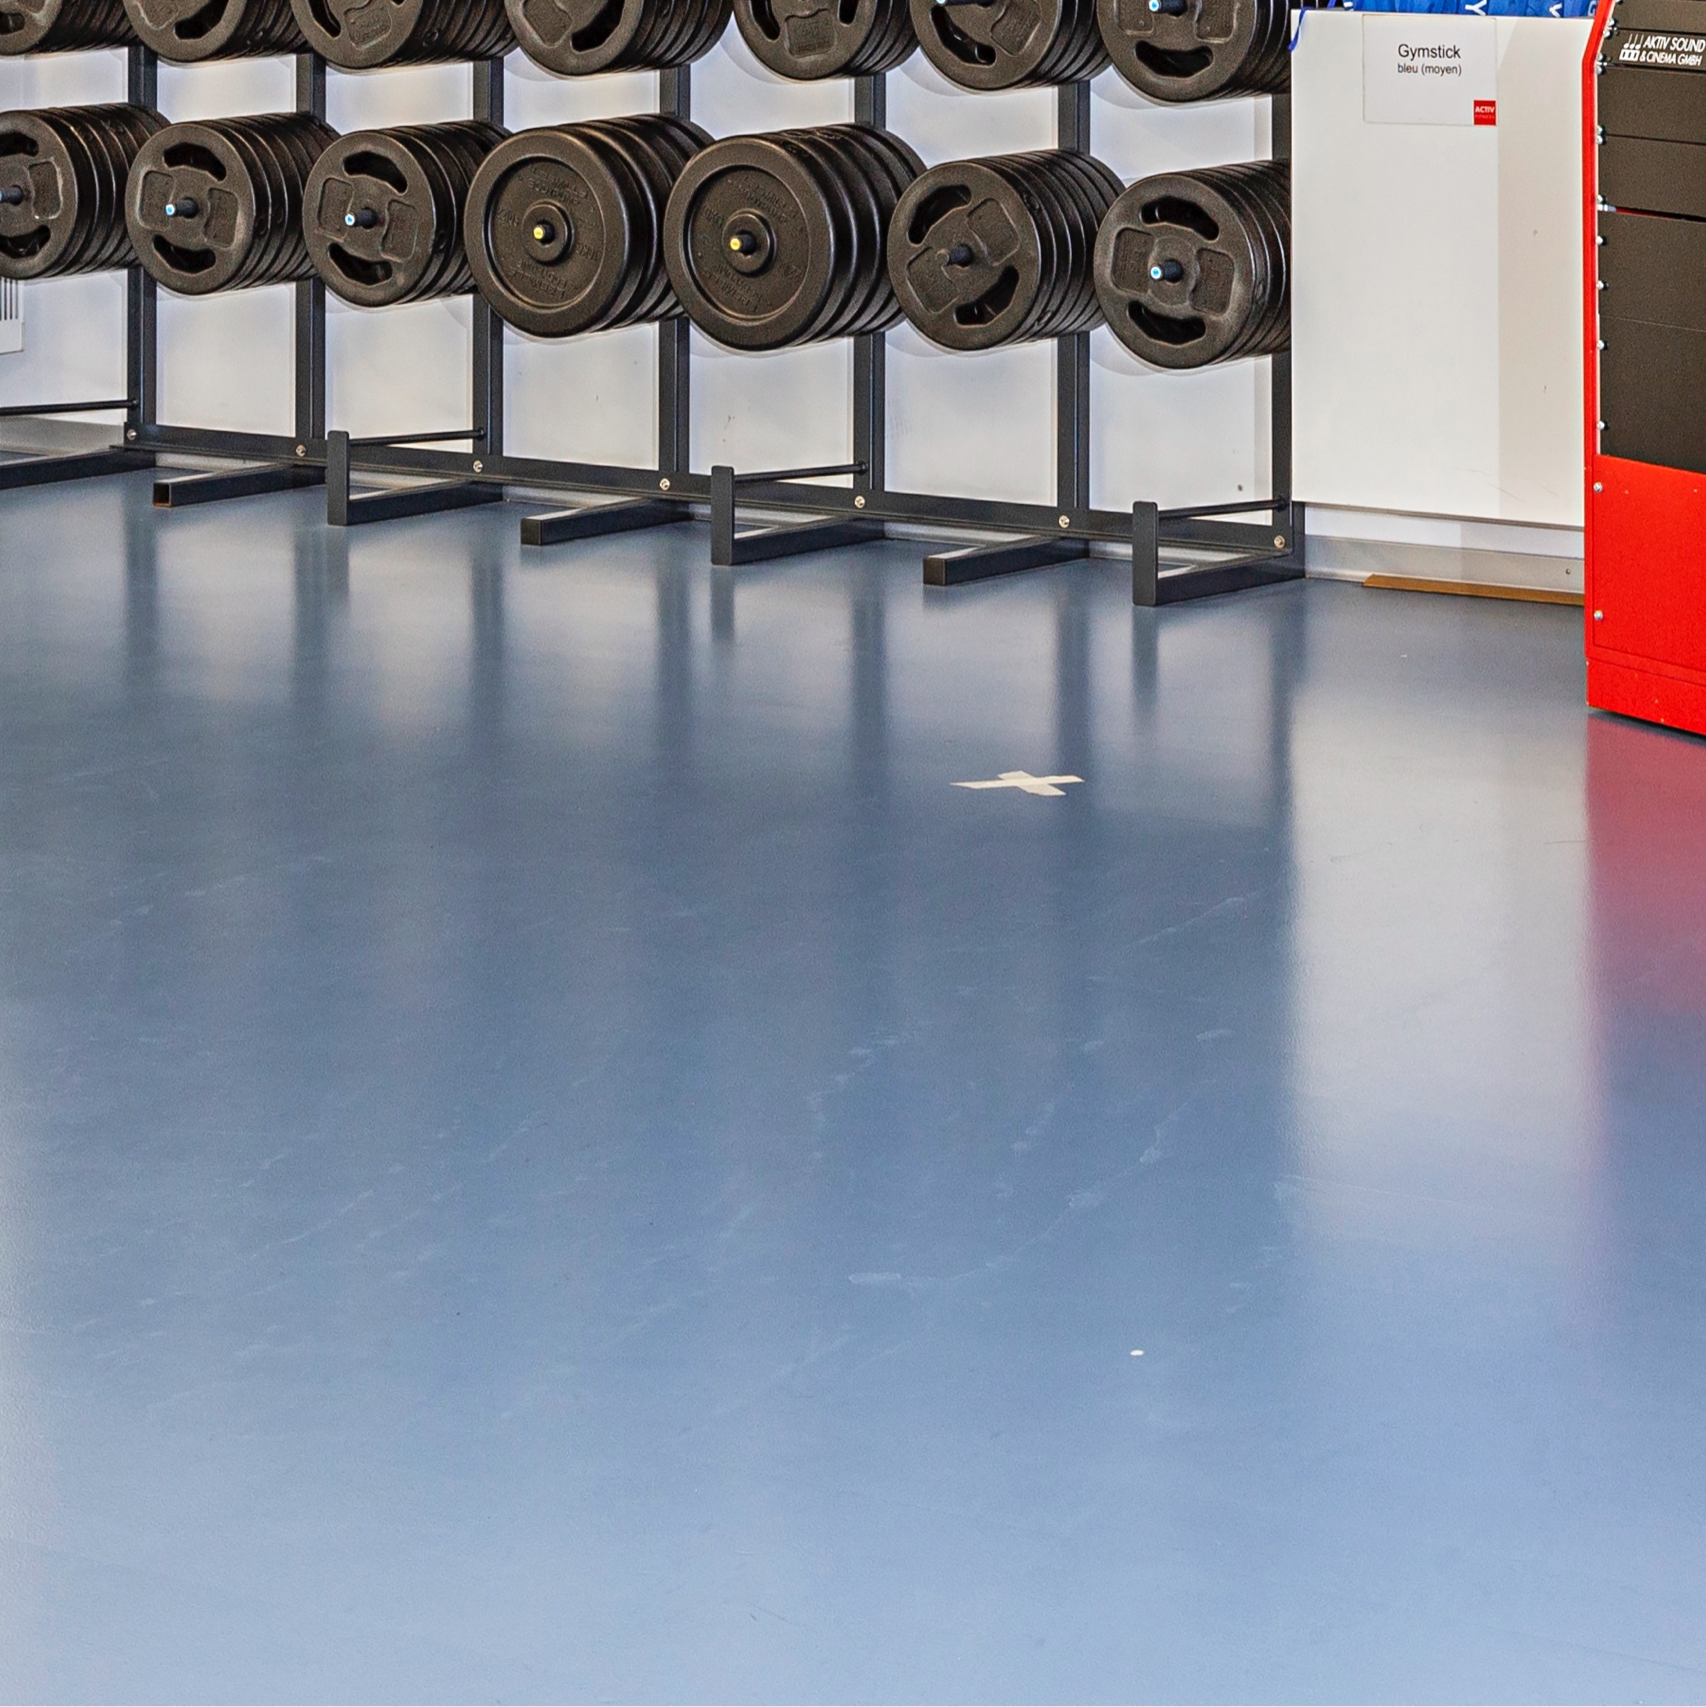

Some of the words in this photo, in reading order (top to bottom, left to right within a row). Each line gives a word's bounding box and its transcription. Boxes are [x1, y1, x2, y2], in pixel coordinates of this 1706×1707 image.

[1643, 35, 1669, 50] AKTIV
[1669, 37, 1706, 52] SOUND
[1397, 43, 1461, 61] Gymstick
[1640, 50, 1647, 62] &
[1646, 50, 1677, 65] CINEMA
[1678, 53, 1703, 66] GMBH
[1397, 62, 1418, 74] bleu
[1421, 63, 1462, 76] (moyen)
[1474, 105, 1495, 114] ACTIV
